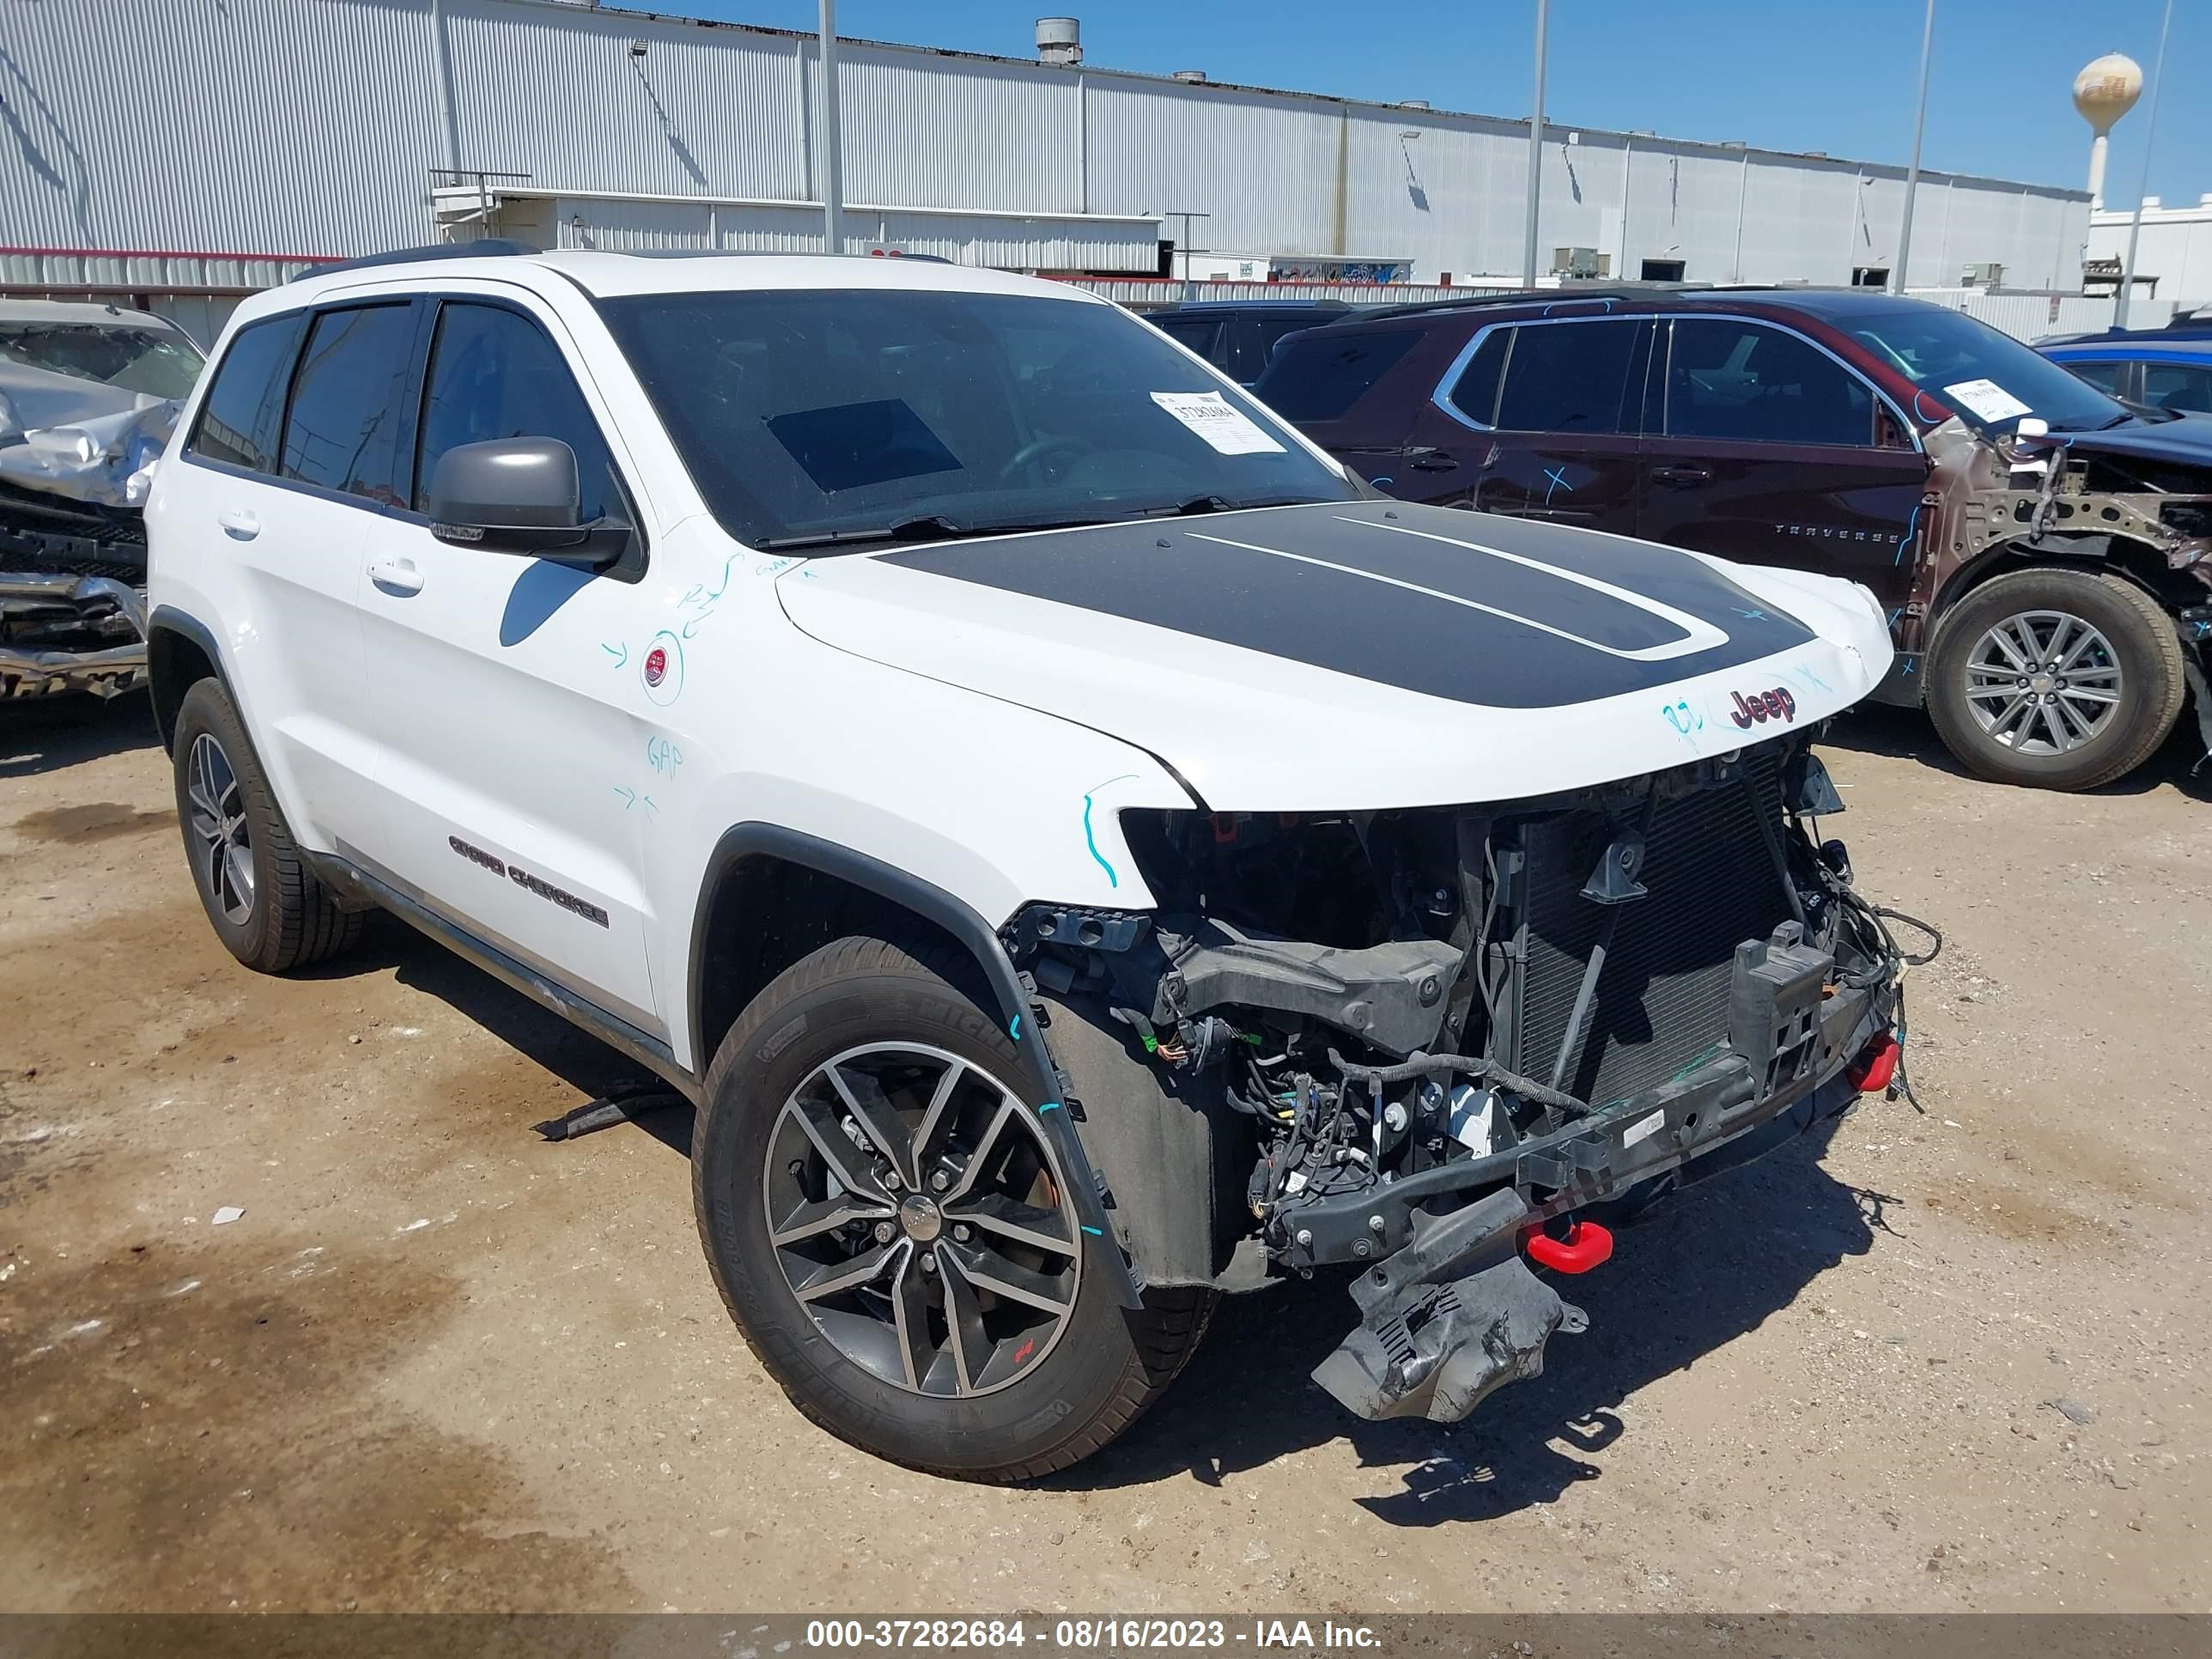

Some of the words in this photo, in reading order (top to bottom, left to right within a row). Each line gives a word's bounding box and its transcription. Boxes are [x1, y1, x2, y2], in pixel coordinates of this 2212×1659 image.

[1774, 524, 1899, 544] TRAVERSE
[1729, 687, 1796, 730] Jeep
[647, 735, 684, 782] GAP
[448, 835, 506, 878] GRAND
[507, 865, 610, 930] CHEROKEE
